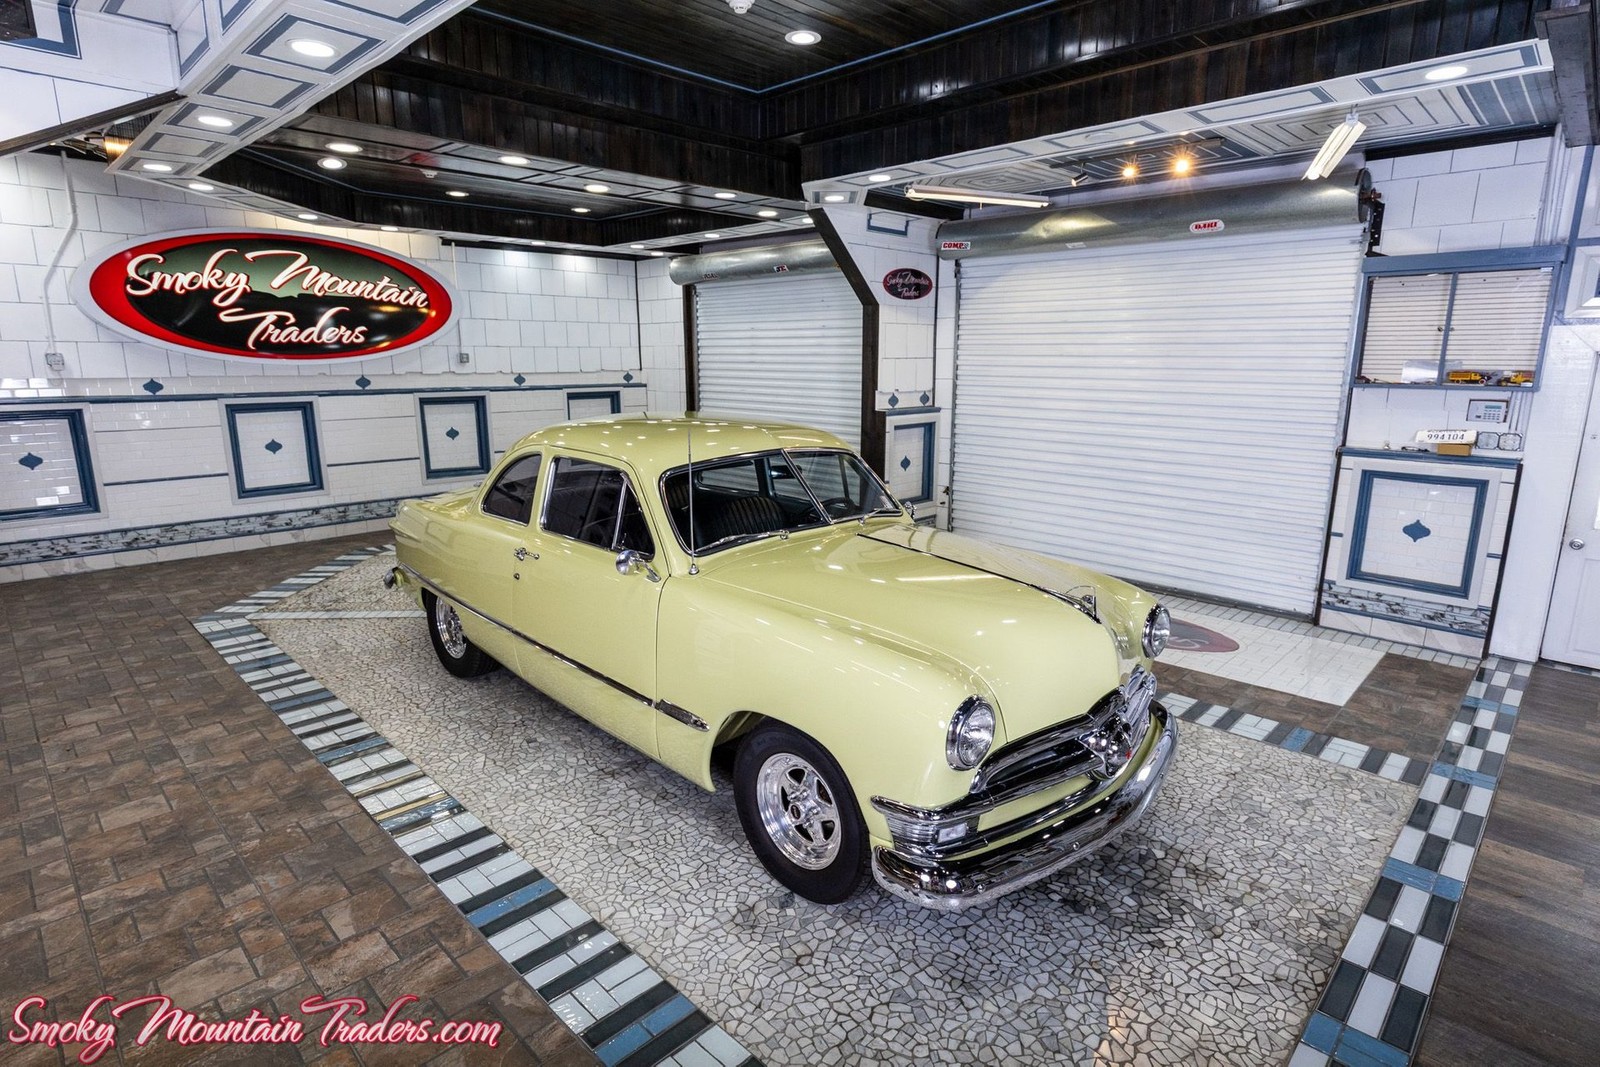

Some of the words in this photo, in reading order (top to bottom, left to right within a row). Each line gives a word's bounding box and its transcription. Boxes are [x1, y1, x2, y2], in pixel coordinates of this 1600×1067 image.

[125, 248, 251, 308] Smoky
[244, 249, 430, 309] Mountain
[218, 306, 368, 351] Traders
